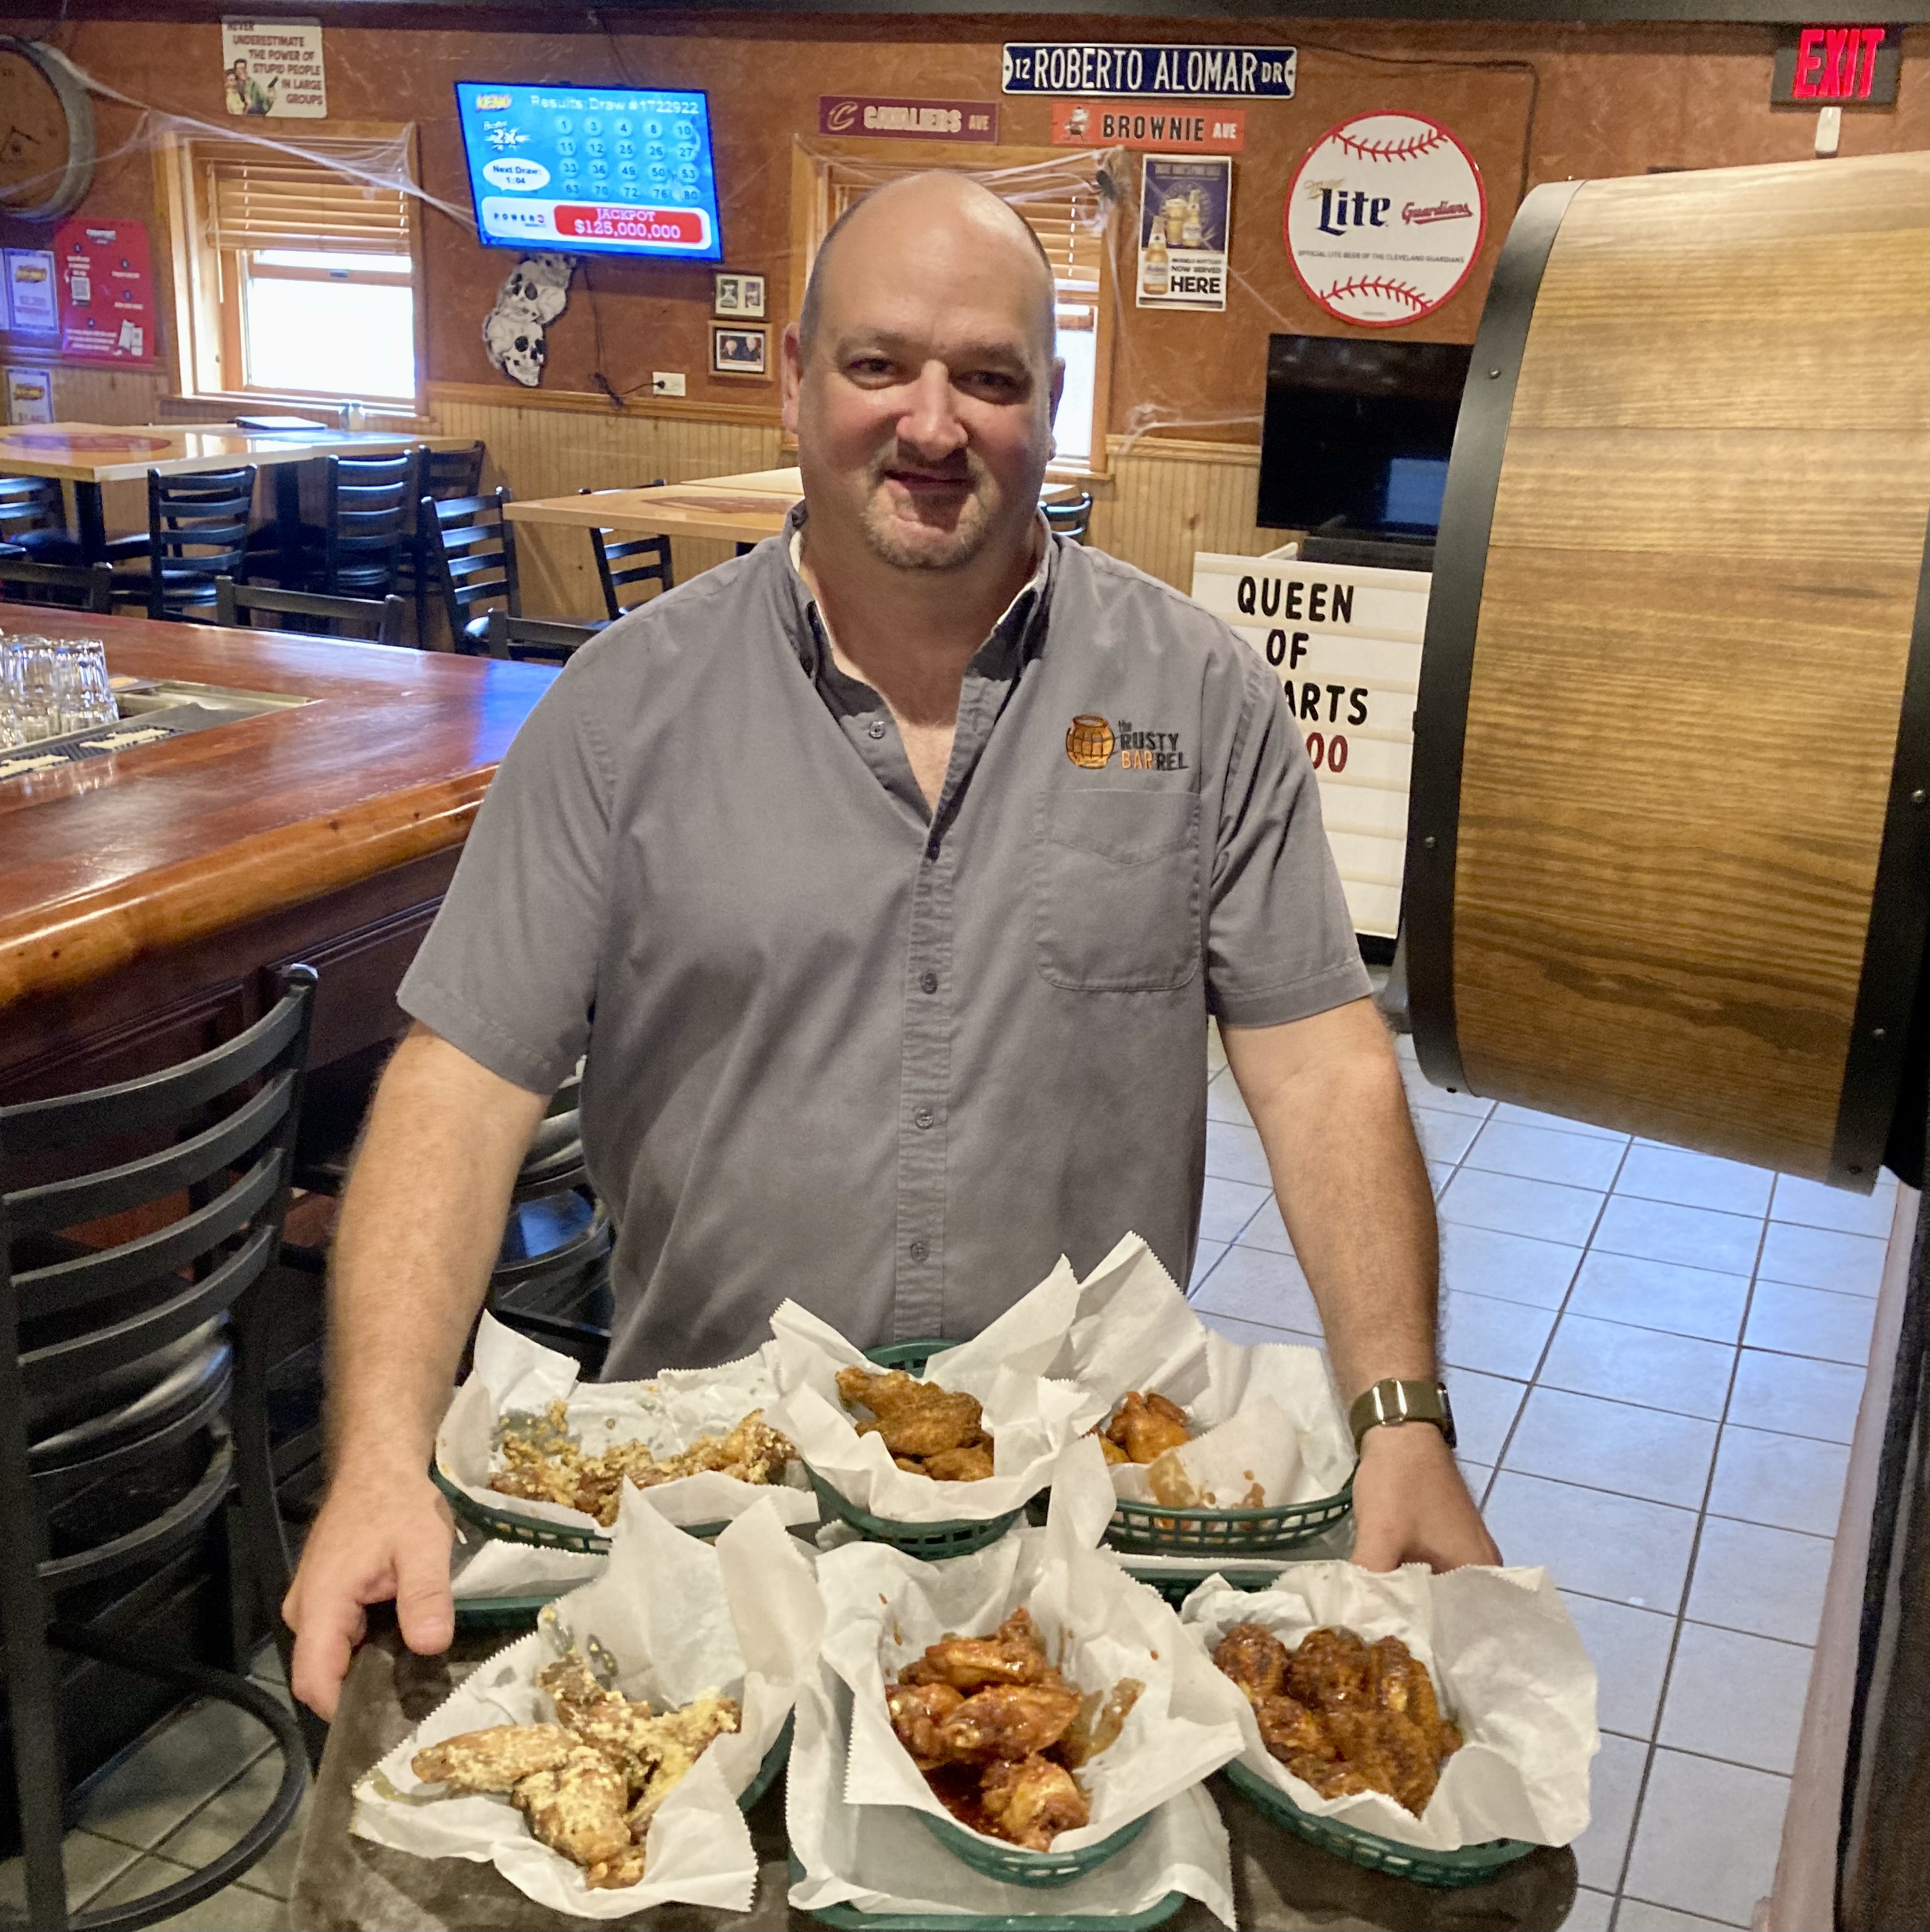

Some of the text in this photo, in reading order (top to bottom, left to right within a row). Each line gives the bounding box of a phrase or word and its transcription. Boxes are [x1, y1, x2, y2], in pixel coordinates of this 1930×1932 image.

[233, 35, 305, 47] UNDERESTIMATE
[248, 49, 315, 61] THE POWER OF
[1792, 29, 1885, 98] EXIT
[253, 63, 321, 75] STUPID PEOPLE
[1015, 48, 1283, 92] 12 ROBERTO ALOMAR DR
[282, 79, 322, 90] IN LARGE
[286, 94, 323, 105] GROUPS
[678, 125, 691, 135] 10
[1102, 114, 1237, 142] BROWNIE AVE
[561, 143, 693, 157] 11 12 25 26 27
[493, 166, 513, 174] Next
[564, 163, 577, 172] 33
[592, 164, 606, 174] 36
[652, 168, 665, 177] 50
[682, 168, 695, 178] 53
[595, 186, 609, 195] 70
[625, 187, 638, 197] 72
[654, 189, 668, 199] 76
[597, 208, 656, 222] JACKPOT
[1315, 188, 1391, 236] Lite
[1402, 201, 1473, 225] Guardians
[575, 219, 681, 240] $125,000,000
[1386, 254, 1424, 262] CLEVELAND
[1171, 276, 1221, 294] HERE
[1238, 576, 1354, 624] QUEEN
[1266, 629, 1309, 670] OF
[1284, 680, 1368, 726] ARTS
[1120, 732, 1179, 751] RUSTY
[1122, 749, 1190, 771] BARREL
[1306, 732, 1348, 773] 00
